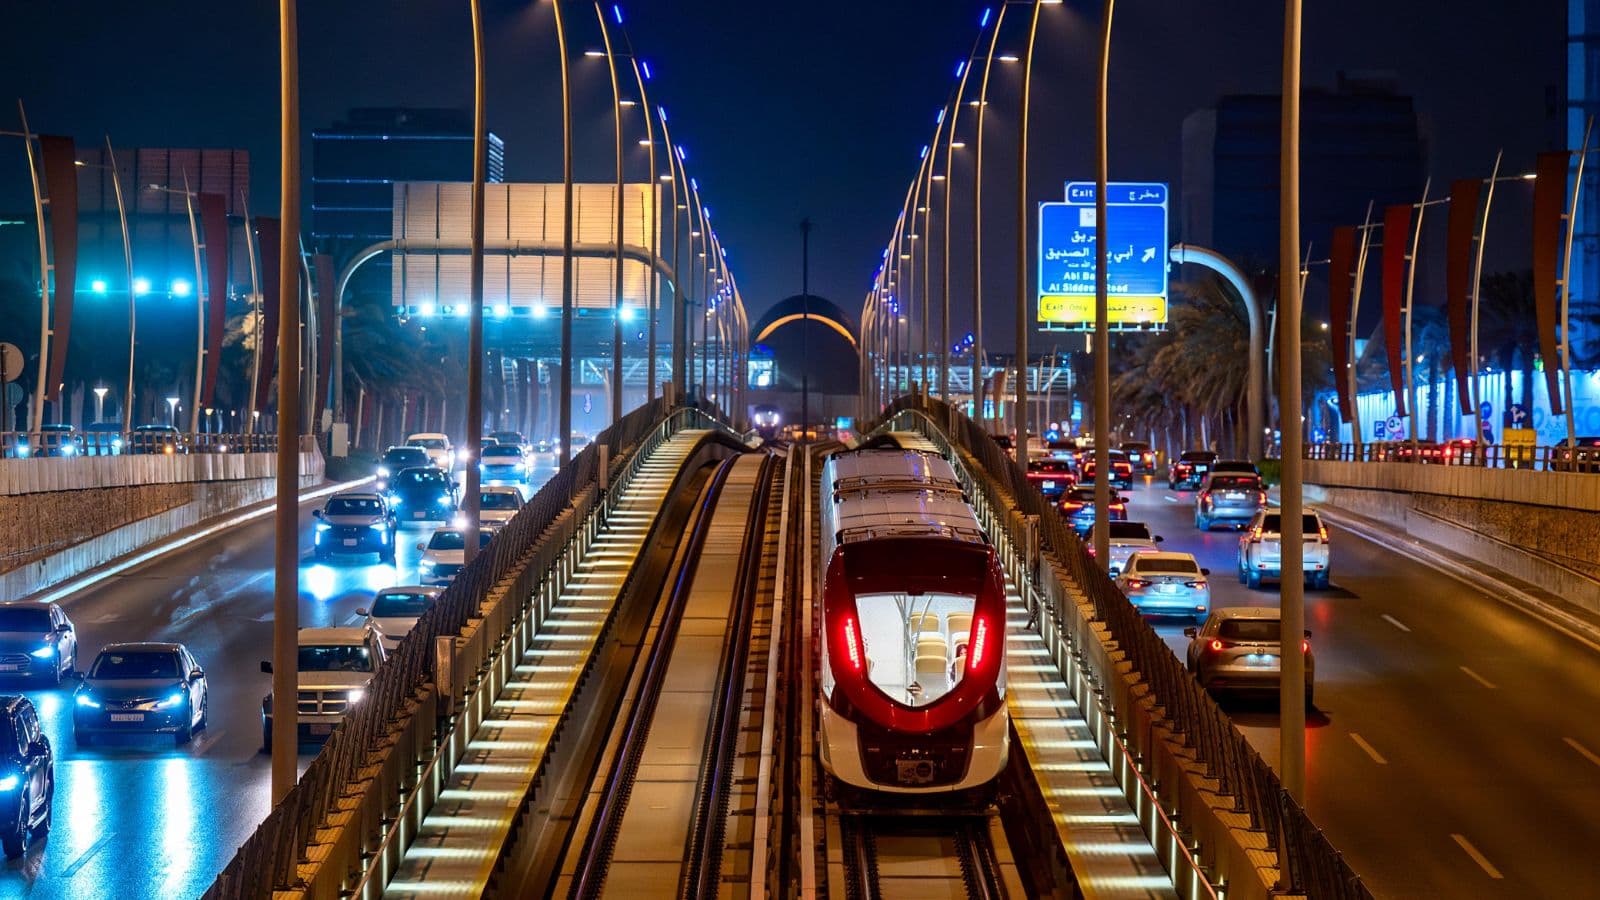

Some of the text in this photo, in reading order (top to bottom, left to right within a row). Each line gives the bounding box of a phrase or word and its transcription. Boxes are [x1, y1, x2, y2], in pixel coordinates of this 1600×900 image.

[1072, 188, 1093, 197] Exit
[1129, 189, 1160, 201] مخرج
[1071, 230, 1096, 243] ريق
[1049, 283, 1060, 292] Al
